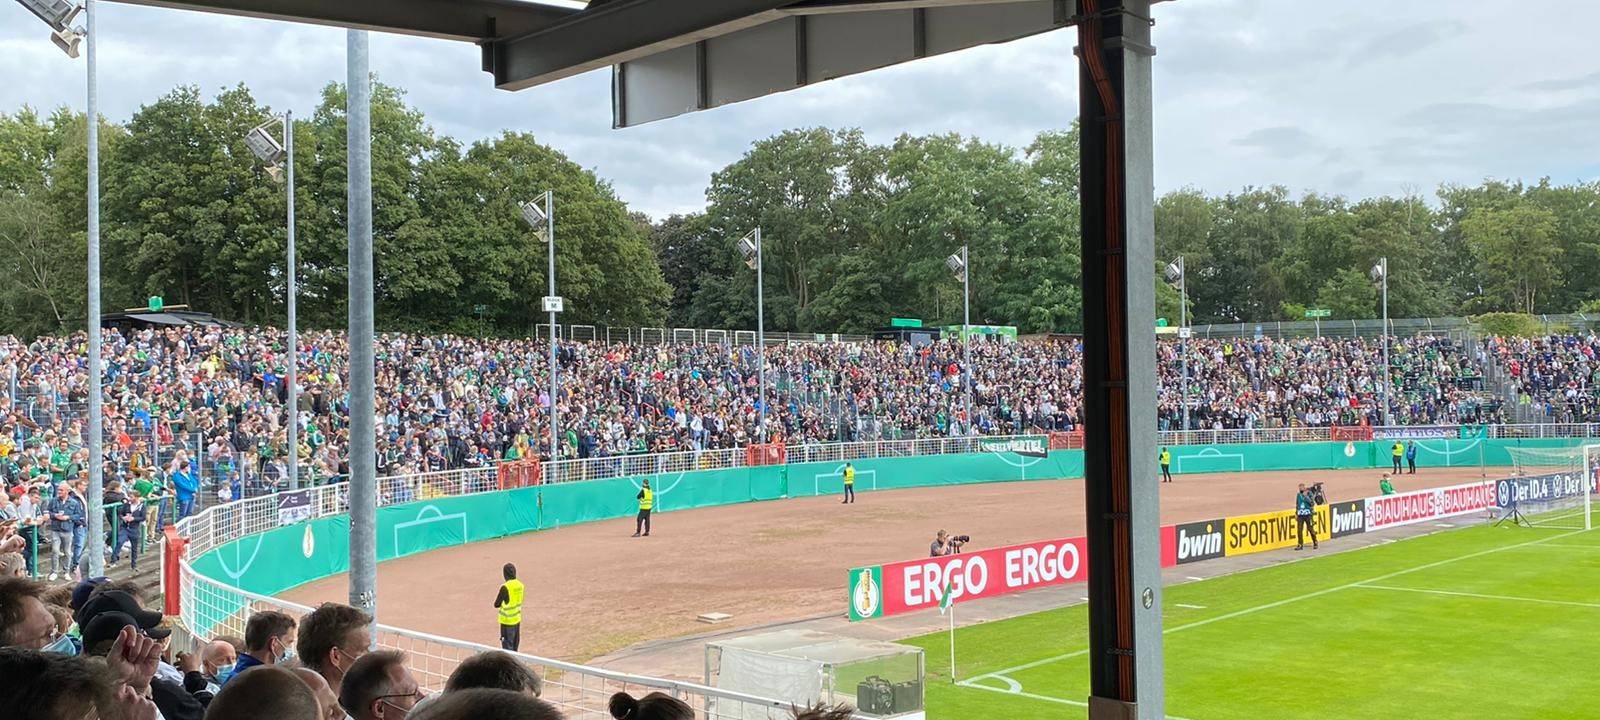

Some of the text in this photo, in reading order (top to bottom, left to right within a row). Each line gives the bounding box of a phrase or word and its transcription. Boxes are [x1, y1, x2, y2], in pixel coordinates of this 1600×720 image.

[1385, 428, 1447, 438] MYTHOS
[1445, 485, 1495, 512] BAUHAUS
[1512, 481, 1528, 501] Der
[1530, 479, 1548, 499] ID.4
[1564, 475, 1580, 494] Der
[1331, 503, 1363, 533] bwin
[1375, 494, 1434, 522] BAUHAUS
[1178, 524, 1222, 559] bwin
[1229, 510, 1327, 549] SPORTWEEN
[1005, 543, 1079, 588] ERGO
[904, 555, 987, 606] ERGO
